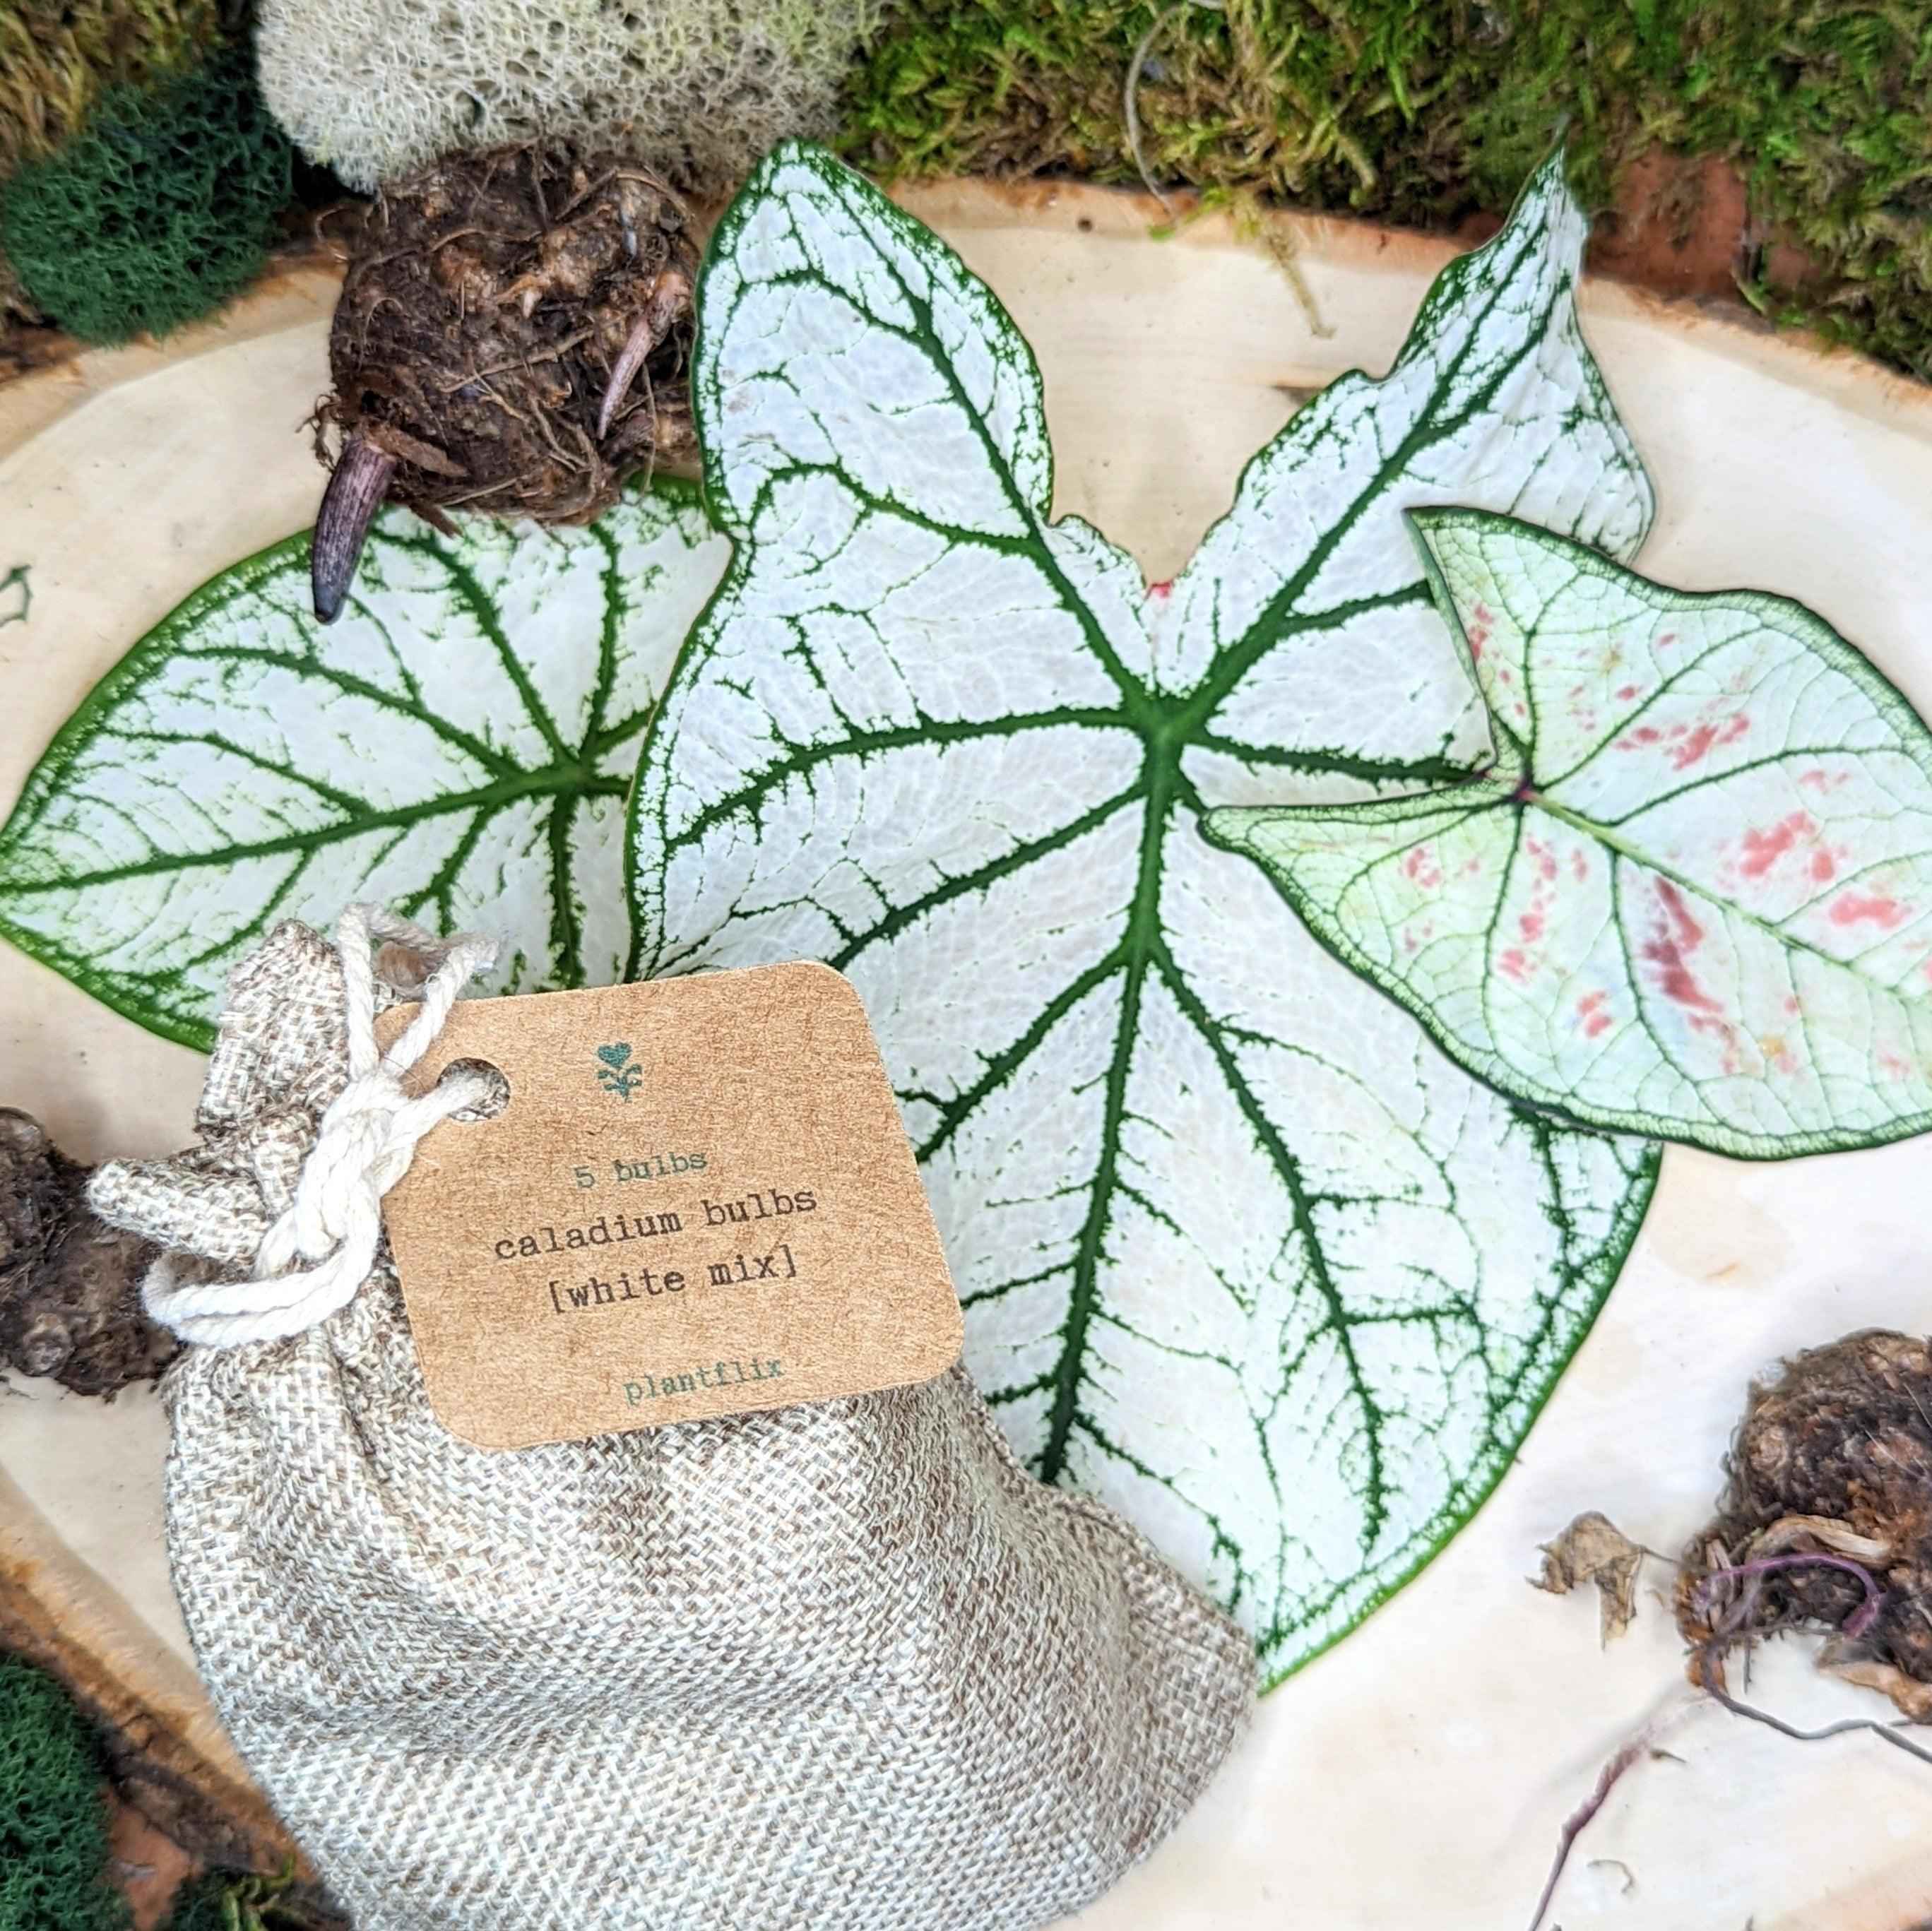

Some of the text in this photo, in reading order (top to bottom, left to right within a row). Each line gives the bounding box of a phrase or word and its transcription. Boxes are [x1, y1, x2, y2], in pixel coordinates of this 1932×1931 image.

[574, 1152, 708, 1189] 5 bulbs
[494, 1189, 818, 1259] caladium bulbs
[548, 1244, 797, 1314] [white mix]
[623, 1357, 785, 1406] plantflix
